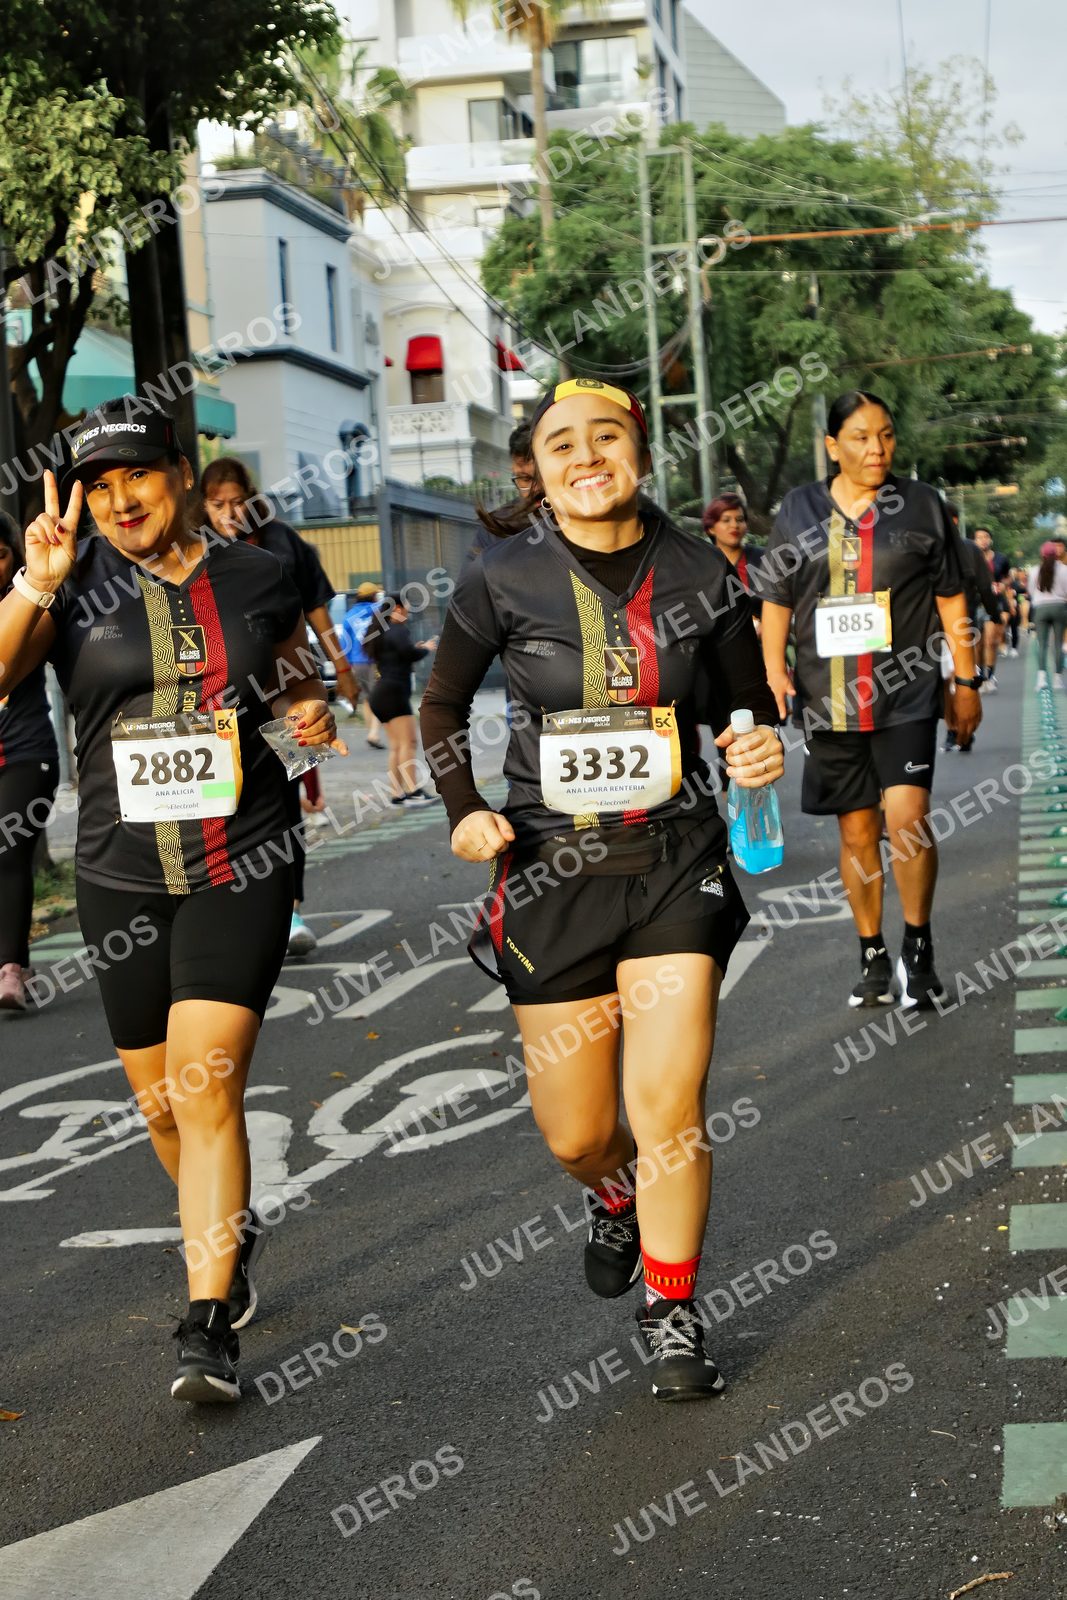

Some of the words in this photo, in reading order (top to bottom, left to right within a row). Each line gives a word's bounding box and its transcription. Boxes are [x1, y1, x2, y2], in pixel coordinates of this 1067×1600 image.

[101, 423, 146, 434] NEGROS
[827, 612, 874, 634] 1885
[582, 715, 610, 723] NEGROS
[655, 717, 672, 728] 5K
[149, 721, 175, 729] NEGROS
[217, 719, 232, 731] 5K
[129, 747, 215, 785] 2882
[559, 744, 650, 783] 3332
[155, 789, 170, 797] ANA
[171, 788, 195, 796] ALICIA
[506, 936, 535, 974] TOPTIME
